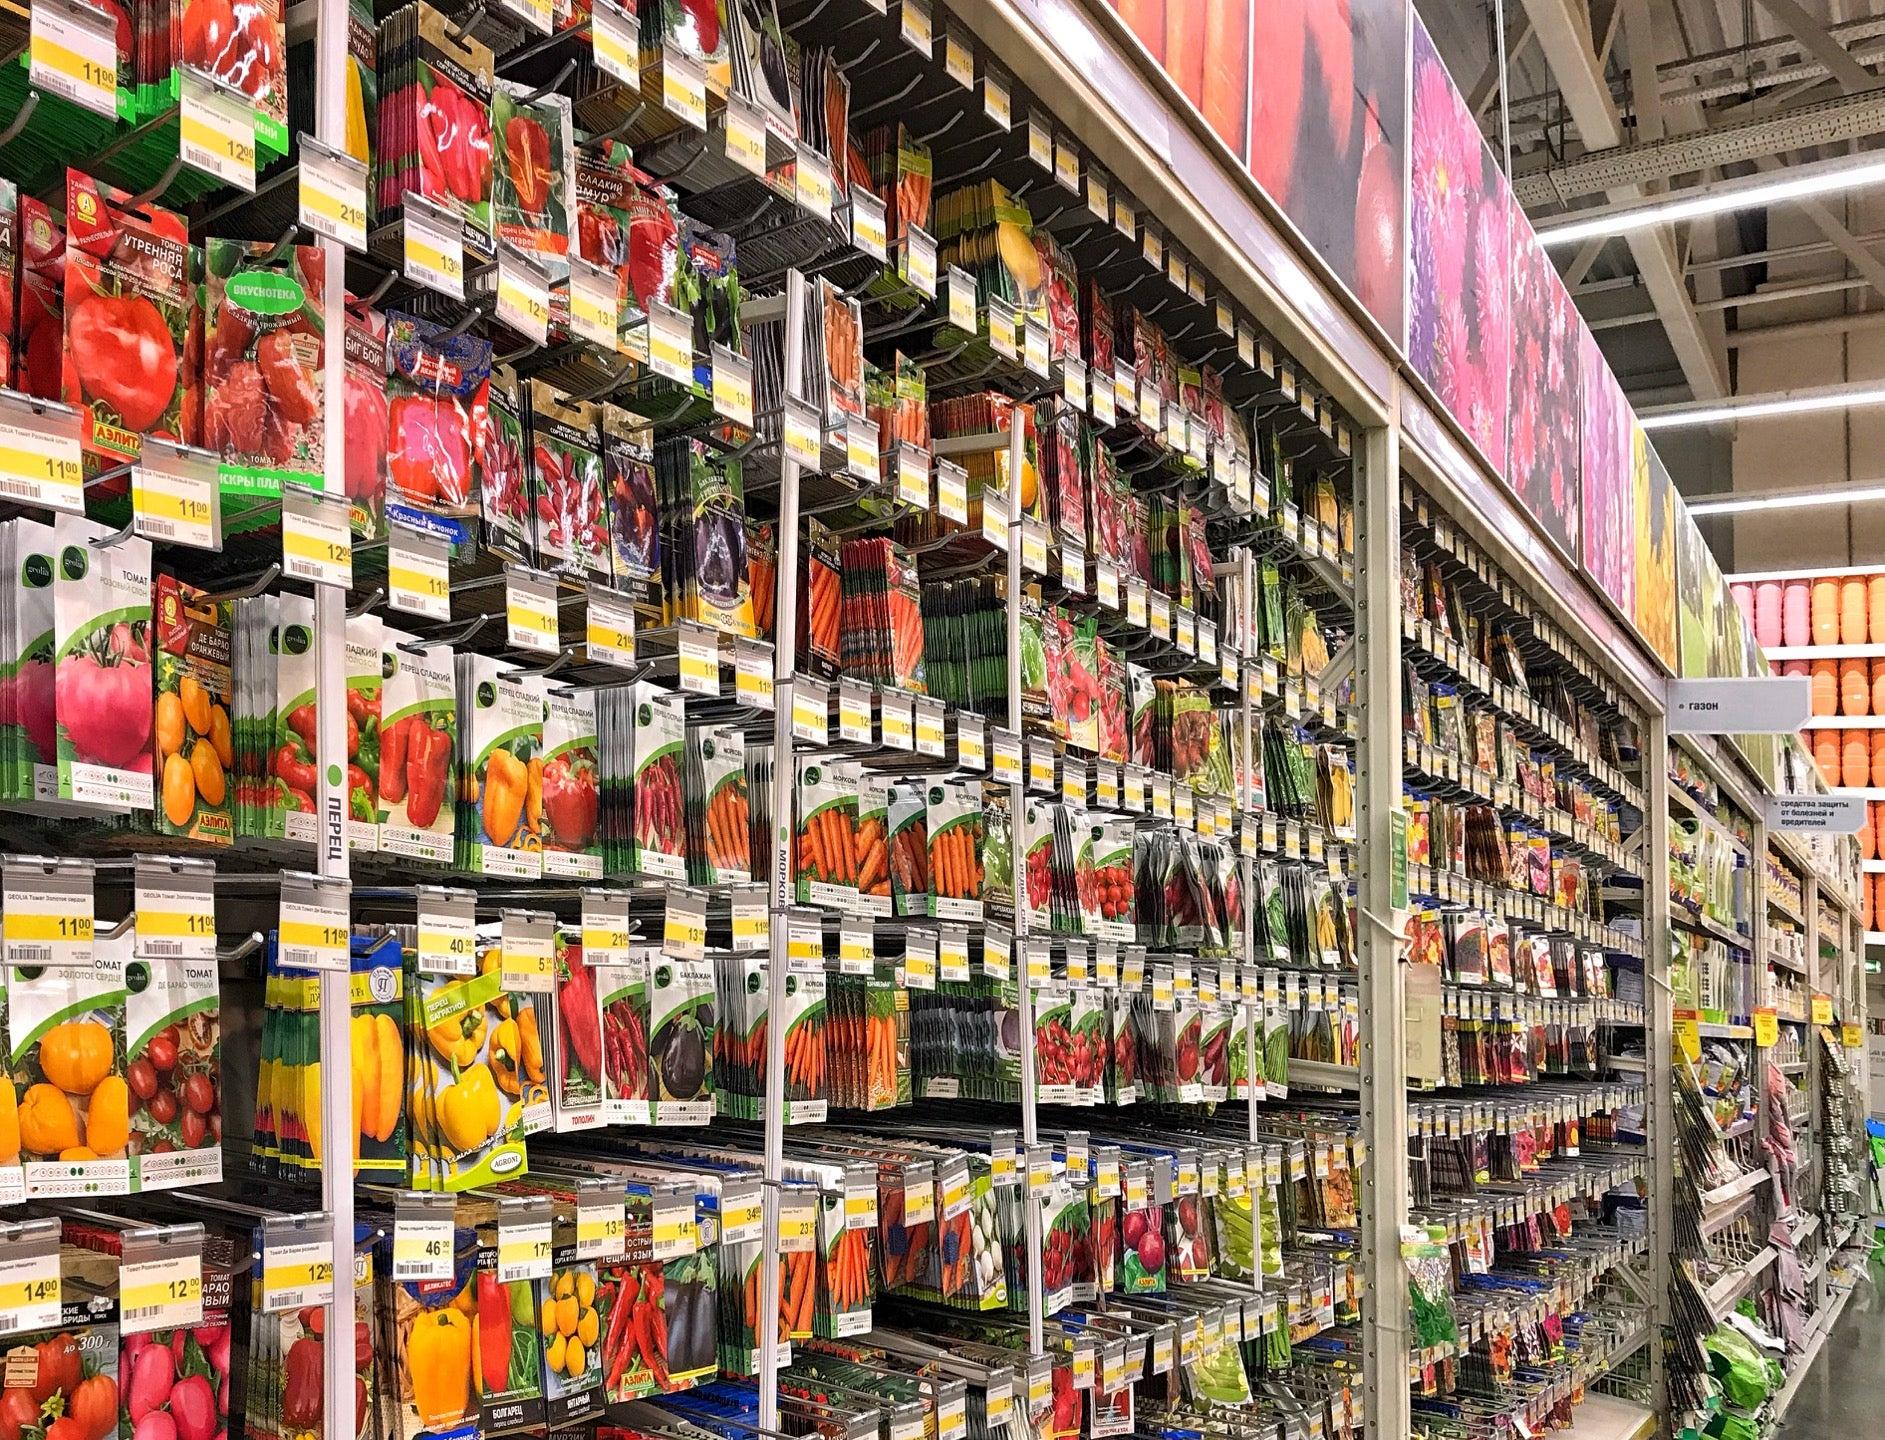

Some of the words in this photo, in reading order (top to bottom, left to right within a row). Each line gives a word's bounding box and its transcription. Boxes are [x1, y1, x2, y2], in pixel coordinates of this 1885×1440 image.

[579, 172, 623, 193] СЛАДКИЙ
[124, 233, 183, 266] УТРЕННЯЯ
[161, 239, 183, 252] ТОМАТ
[152, 259, 183, 280] РОСА
[233, 285, 297, 301] ВКУСНОТЕКА
[346, 337, 361, 355] БИГ
[393, 508, 427, 529] Красный
[122, 570, 148, 586] ТОМАТ
[198, 633, 208, 644] ДЕ
[208, 636, 230, 651] БАРАО
[191, 641, 230, 662] ОРАНЖЕВЫЙ
[346, 644, 378, 658] ЛАДКИЙ
[400, 663, 419, 676] ПЕРЕЦ
[420, 668, 451, 683] СЛАДКИЙ
[499, 687, 515, 698] ПЕРЕЦ
[515, 690, 541, 703] СЛАДКИЙ
[568, 707, 594, 718] СЛАДКИЙ
[1689, 702, 1719, 711] газон
[832, 774, 858, 785] МОРКОВЬ
[199, 814, 229, 830] АЭЛИТА
[328, 797, 342, 861] ПЕРЕЦ
[95, 960, 122, 970] ОМАТ
[185, 969, 213, 979] ТОМАТ
[679, 971, 712, 980] БАКЛАЖАН
[571, 1114, 595, 1126] ТОПОЛИН
[494, 1155, 519, 1168] AGRONI
[425, 1240, 441, 1256] 46
[210, 1274, 230, 1282] ТОМАТ
[24, 1280, 58, 1302] 1400
[202, 1283, 230, 1294] АРАО
[78, 1336, 103, 1352] 300
[624, 1375, 652, 1387] АЭЛИТА
[567, 1395, 591, 1410] ЯНТАРНЫЙ
[492, 1405, 523, 1420] БОЛГАРЕЦ
